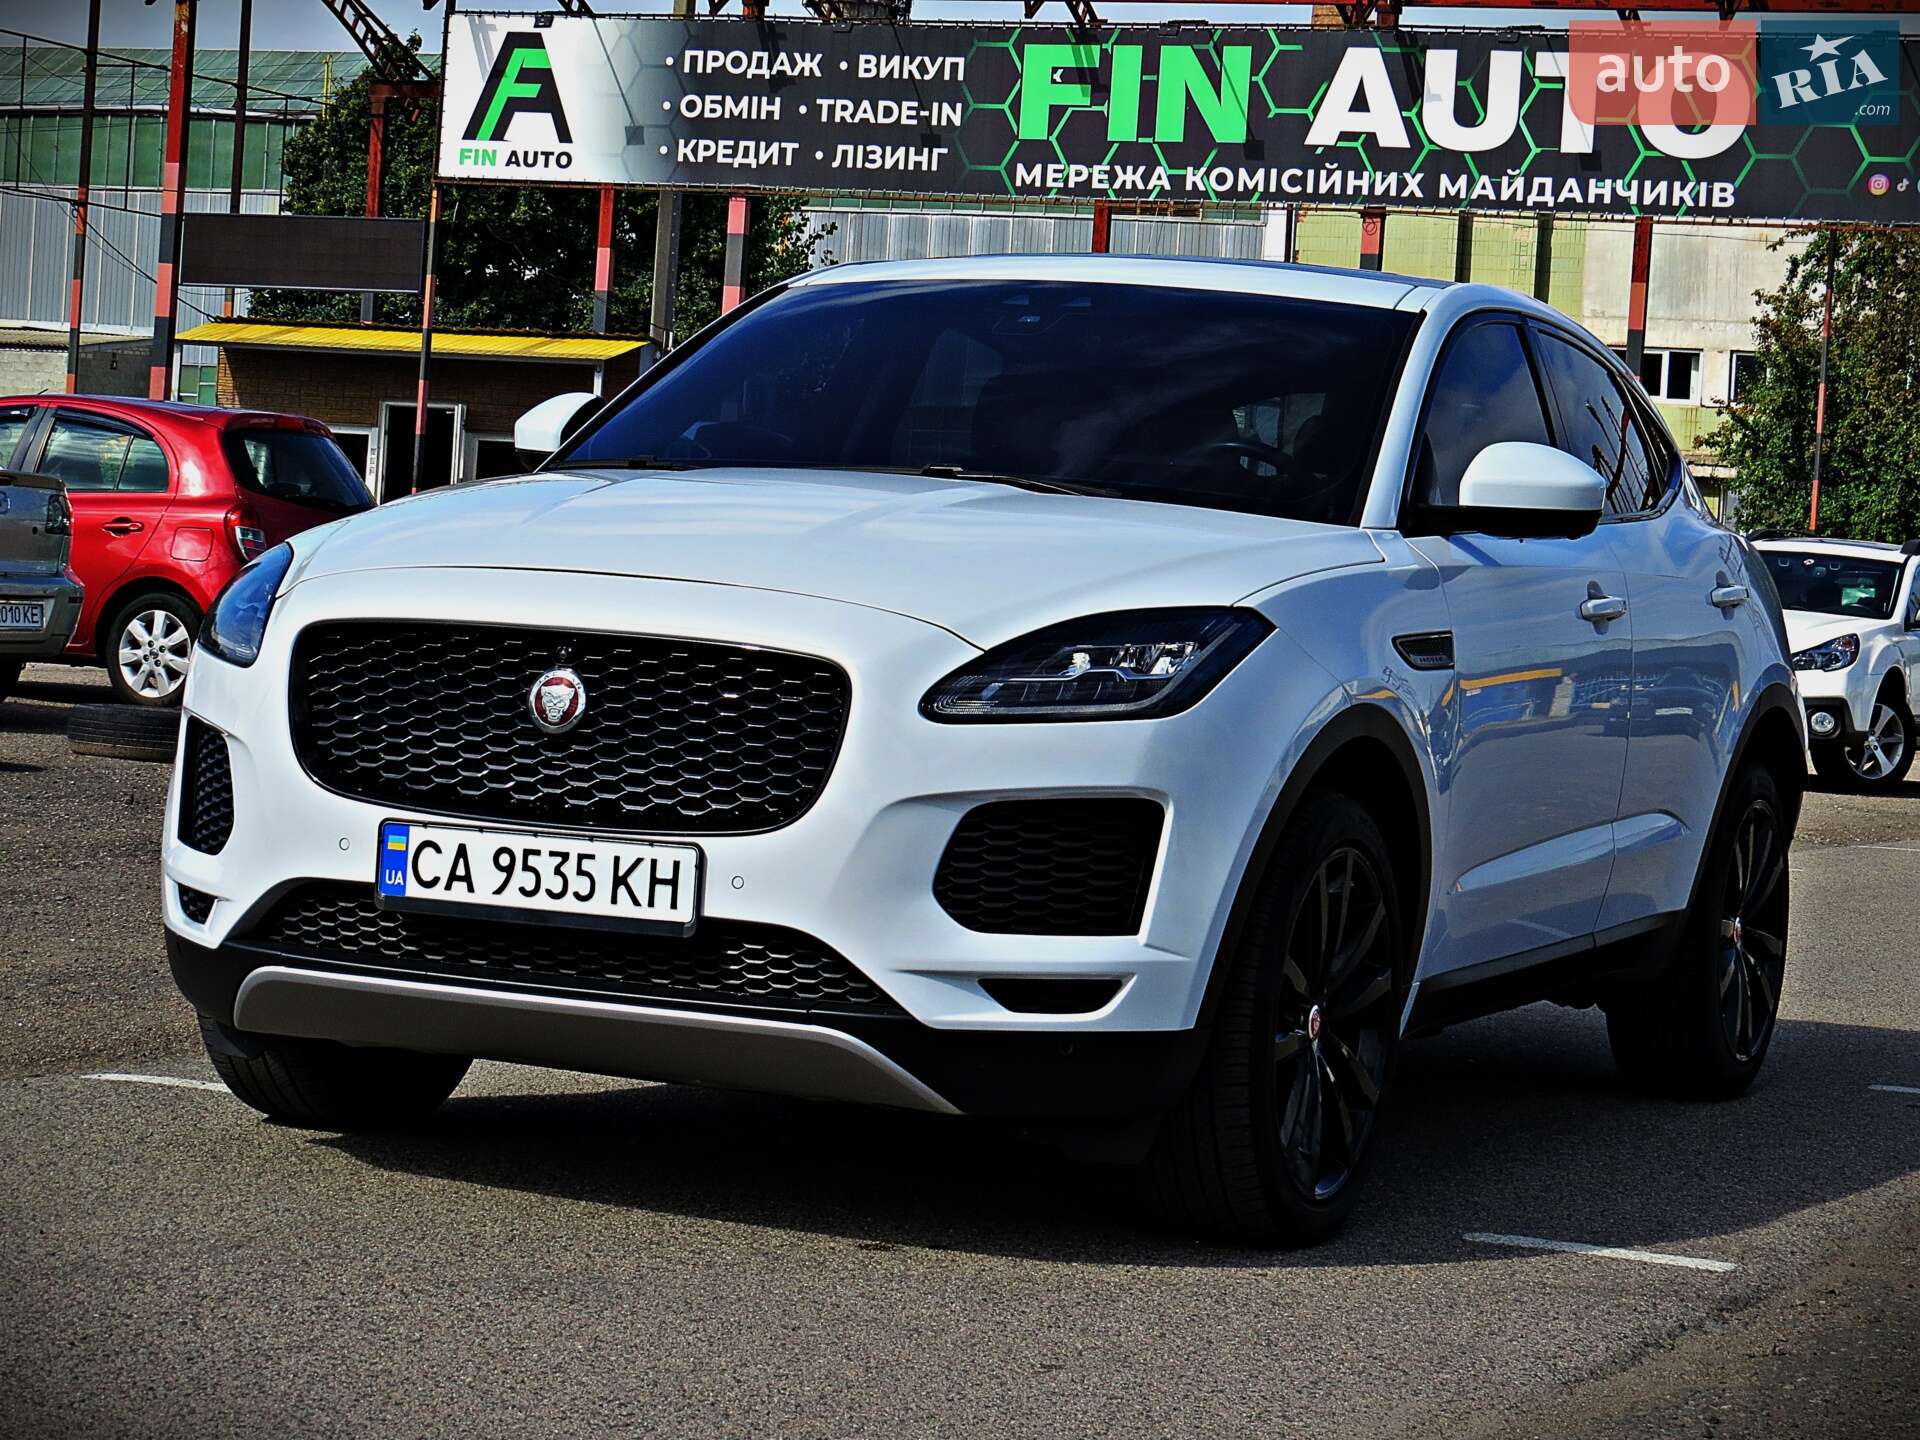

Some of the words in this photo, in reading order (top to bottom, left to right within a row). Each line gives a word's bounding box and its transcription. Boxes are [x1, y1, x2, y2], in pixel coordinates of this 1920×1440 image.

[683, 50, 823, 79] ПРОДАЖ
[857, 54, 965, 81] ВИКУП
[679, 94, 781, 120] ОБМІН
[816, 98, 963, 126] TRADE-IN
[1018, 44, 1252, 144] FIN
[1304, 46, 1752, 160] AUTO
[459, 148, 497, 166] FIN
[505, 149, 573, 168] AUTO
[677, 138, 799, 168] КРЕДИТ
[831, 144, 948, 171] ЛІЗИНГ
[1015, 162, 1171, 191] МЕРЕЖА
[1185, 163, 1424, 199] КОМІСІЙНИХ
[1439, 169, 1736, 209] МАЙДАНЧИКІВ
[385, 869, 405, 886] UA
[411, 839, 475, 893] CA
[492, 846, 596, 901] 9535
[610, 855, 681, 910] KH
